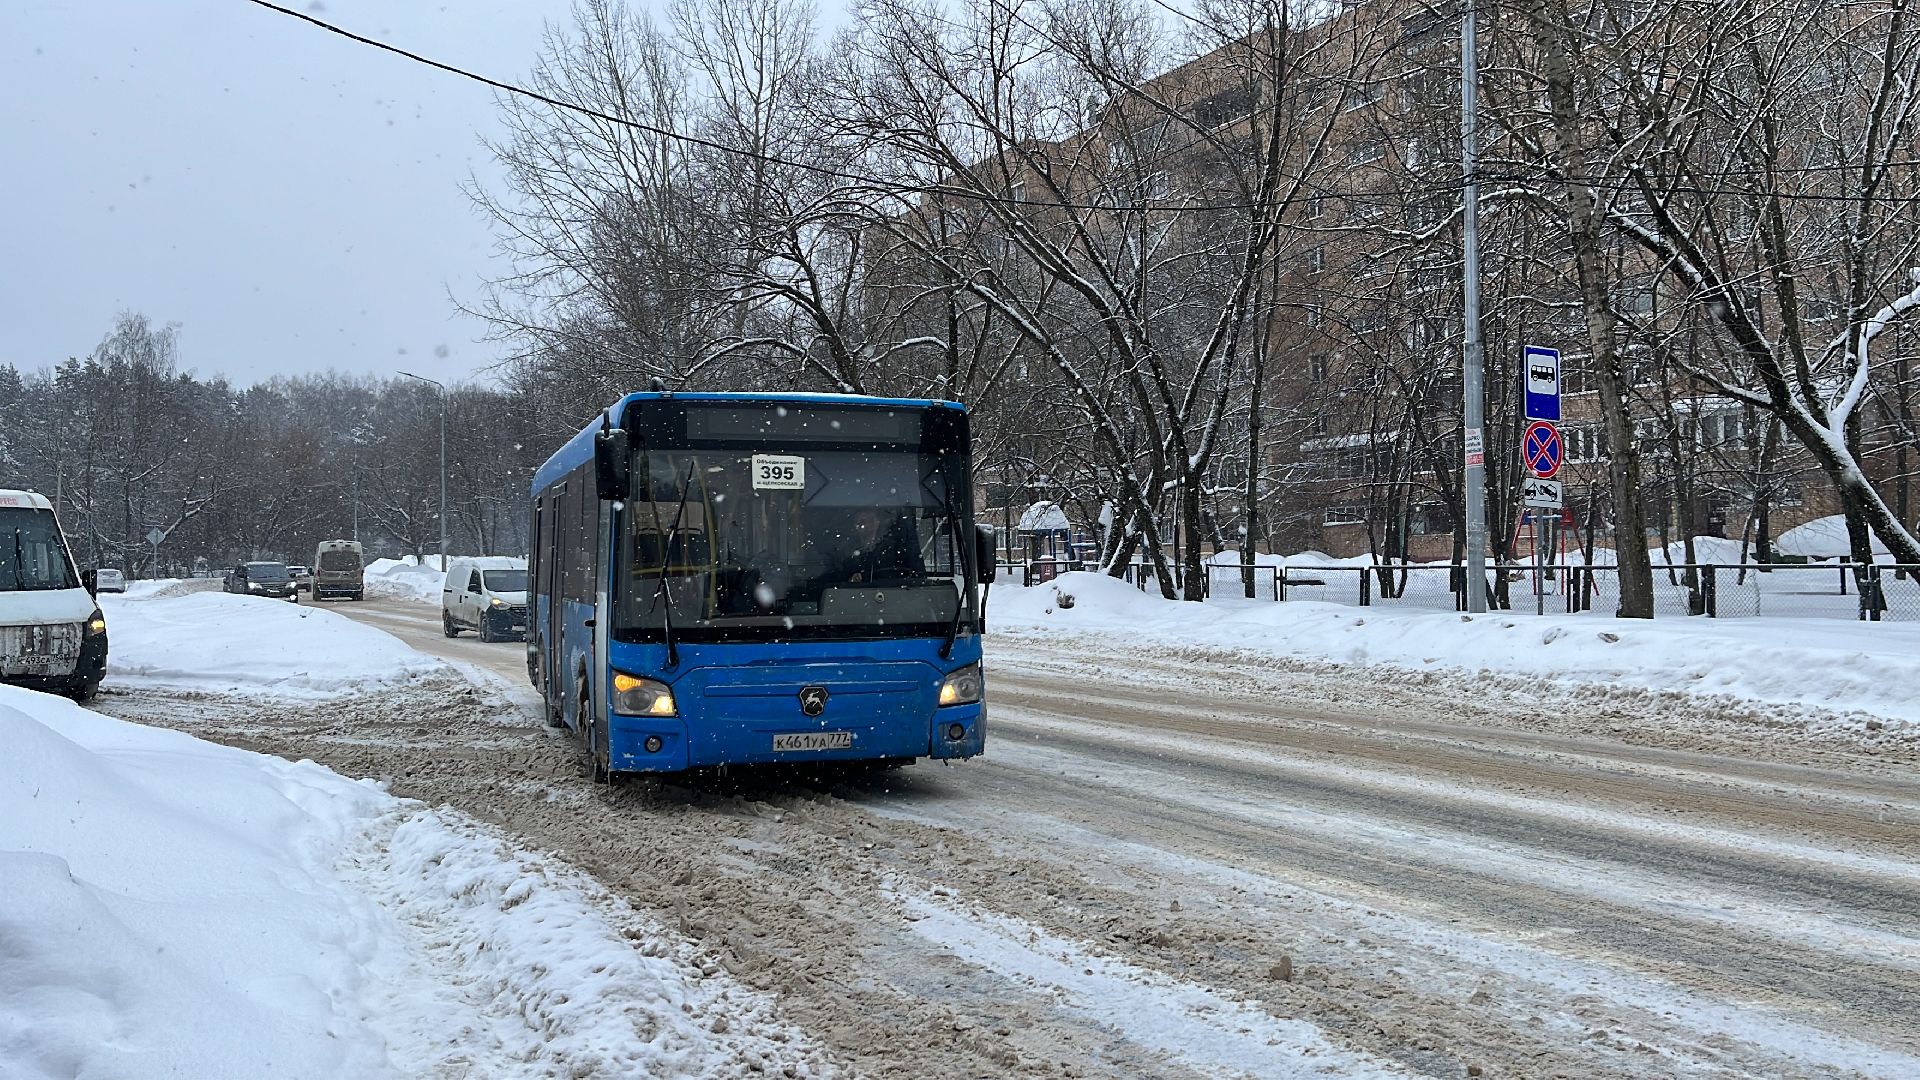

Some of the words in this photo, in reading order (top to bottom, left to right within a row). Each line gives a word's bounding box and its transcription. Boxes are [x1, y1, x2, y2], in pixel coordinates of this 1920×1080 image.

[760, 465, 794, 480] 395
[776, 735, 827, 749] К461УА
[829, 733, 848, 743] 777
